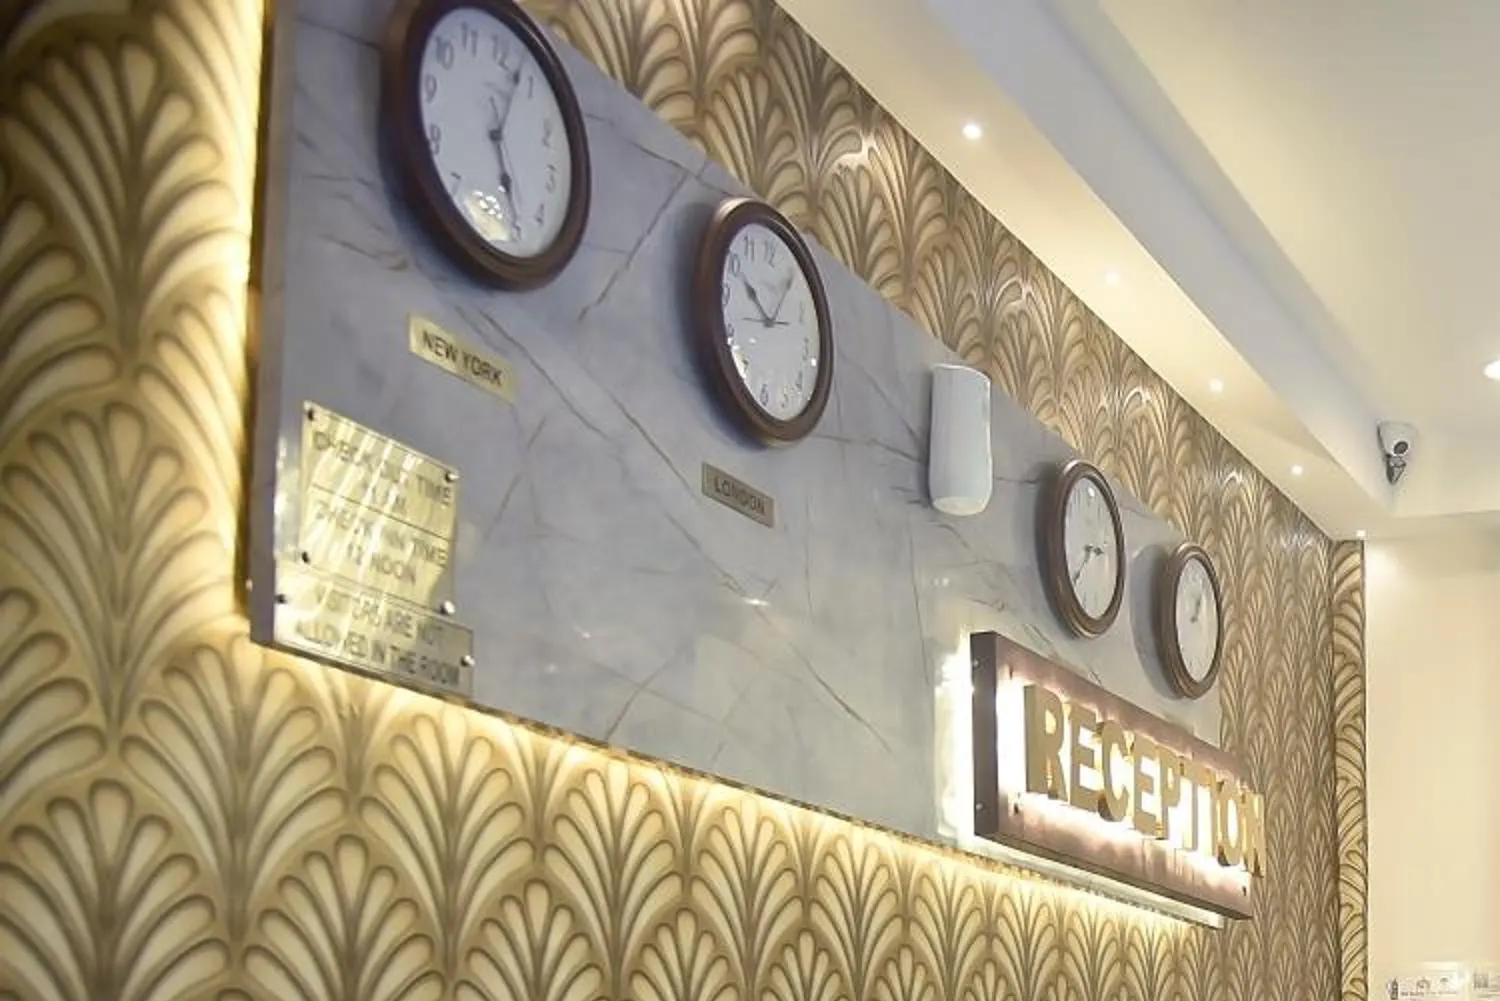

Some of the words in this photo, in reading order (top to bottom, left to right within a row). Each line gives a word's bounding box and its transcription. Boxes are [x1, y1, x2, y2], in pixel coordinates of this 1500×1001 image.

[435, 36, 455, 71] 10
[460, 20, 479, 58] 11
[424, 73, 438, 104] 9
[429, 123, 442, 156] 8
[422, 330, 458, 363] NEW
[461, 351, 503, 388] YORK
[415, 472, 452, 510] TIME
[713, 474, 766, 515] LONDON
[411, 537, 449, 571] TIME
[1024, 685, 1264, 878] RECEPTION
